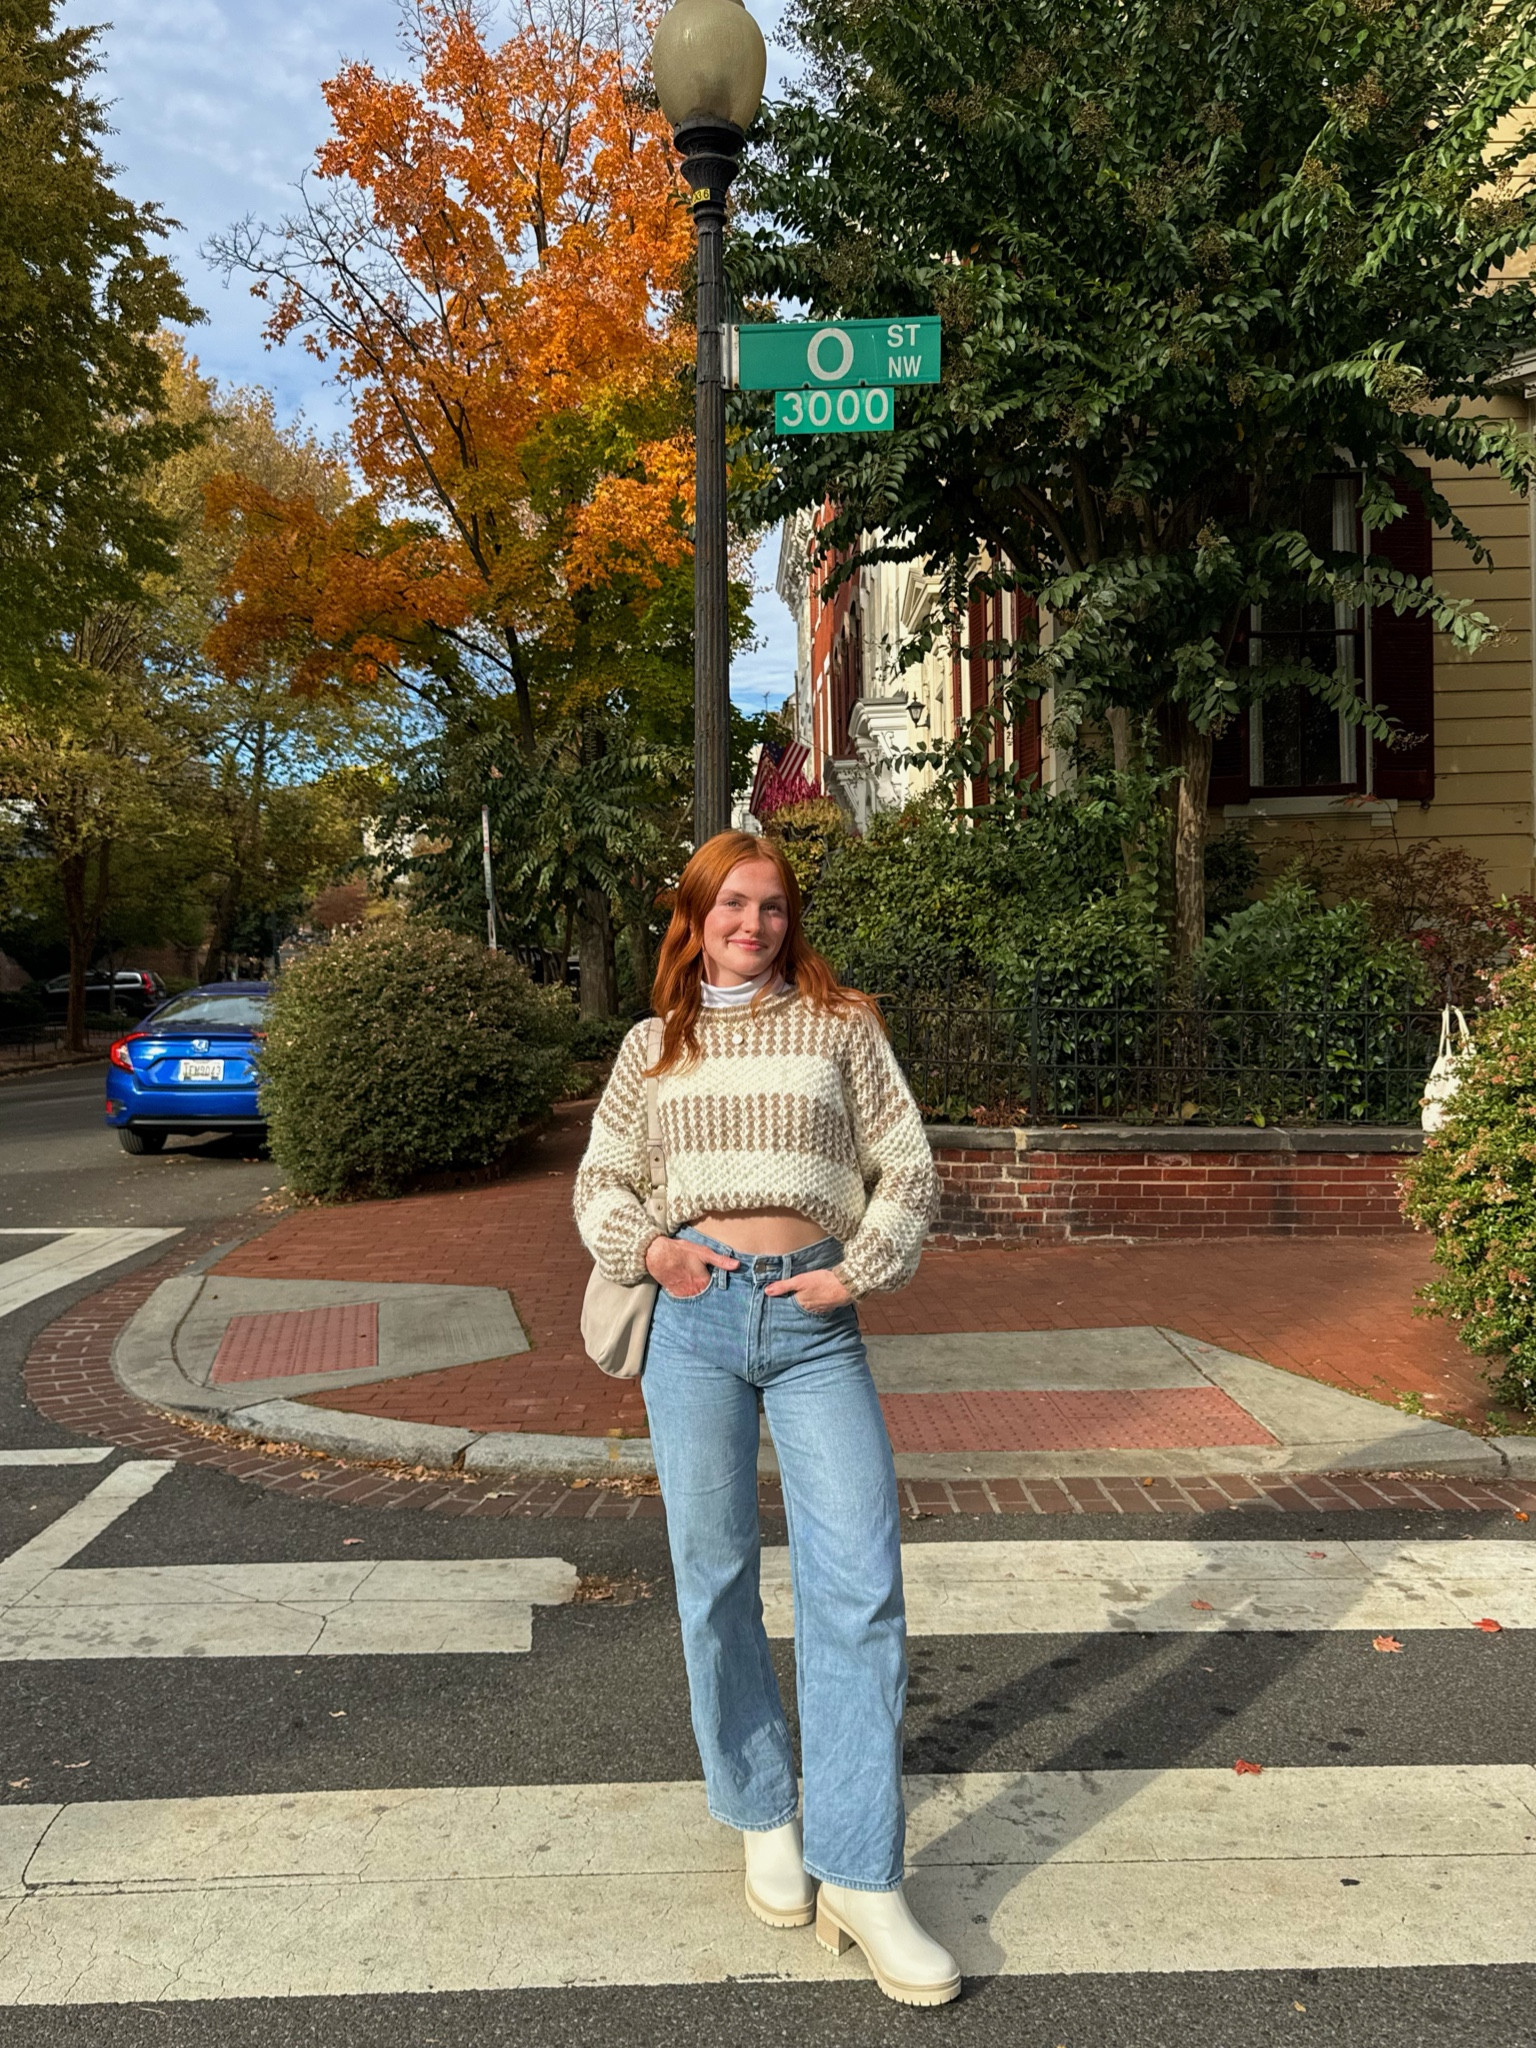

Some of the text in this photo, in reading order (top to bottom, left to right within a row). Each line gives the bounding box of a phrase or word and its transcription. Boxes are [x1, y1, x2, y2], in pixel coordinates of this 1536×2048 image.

[807, 324, 921, 381] O ST
[888, 355, 922, 378] NW
[782, 388, 889, 427] 3000
